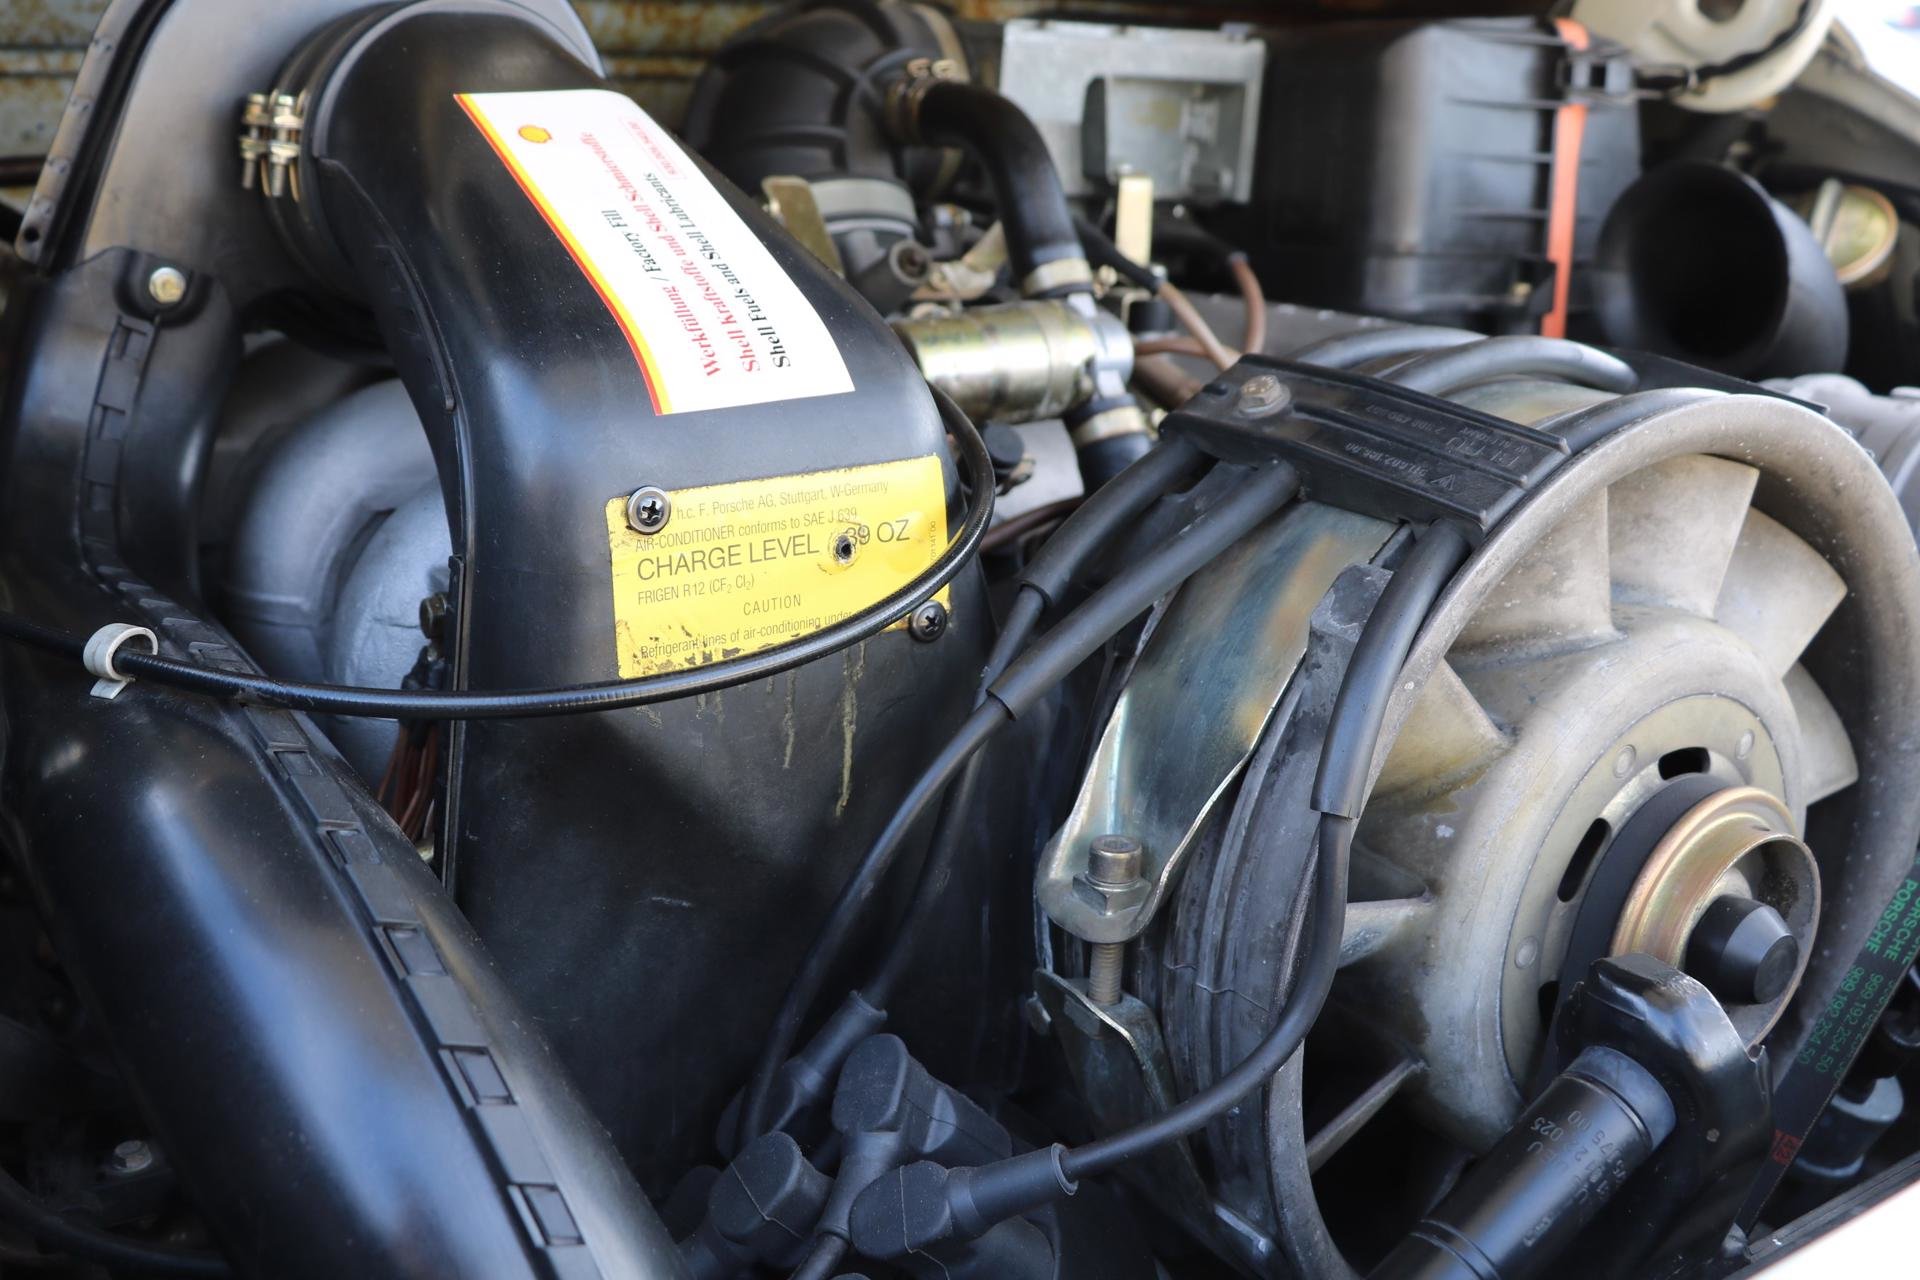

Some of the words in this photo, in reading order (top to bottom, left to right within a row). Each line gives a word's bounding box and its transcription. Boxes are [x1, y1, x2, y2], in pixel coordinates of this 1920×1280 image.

[580, 132, 643, 202] Schmierstoffe
[601, 210, 628, 228] Fill
[633, 204, 668, 233] Shell
[643, 173, 696, 228] Lubricants
[622, 230, 661, 272] Factory
[657, 235, 686, 256] und
[686, 231, 721, 260] Shell
[680, 260, 737, 325] Kraftstoffe
[711, 262, 741, 285] and
[734, 287, 767, 321] Fuels
[662, 286, 721, 376] Werkfüllung
[727, 330, 760, 372] Shell
[757, 326, 791, 368] Shell
[712, 498, 755, 516] Porsche
[830, 481, 889, 499] W-Germany
[635, 526, 735, 553] AIR-CONDITIONER
[738, 519, 787, 537] conforms
[790, 517, 800, 530] to
[803, 511, 825, 527] SAE
[837, 507, 858, 522] 639
[637, 543, 742, 581] CHARGE
[749, 533, 820, 563] LEVEL
[876, 518, 911, 544] OZ
[637, 586, 680, 605] FRIGEN
[743, 594, 802, 616] CAUTION
[640, 638, 700, 660] Refrigerant
[702, 634, 727, 647] lines
[730, 629, 740, 641] of
[743, 616, 821, 641] air-conditioning
[1865, 878, 1919, 954] PORSCHE
[1883, 897, 1920, 961] ORSCHE
